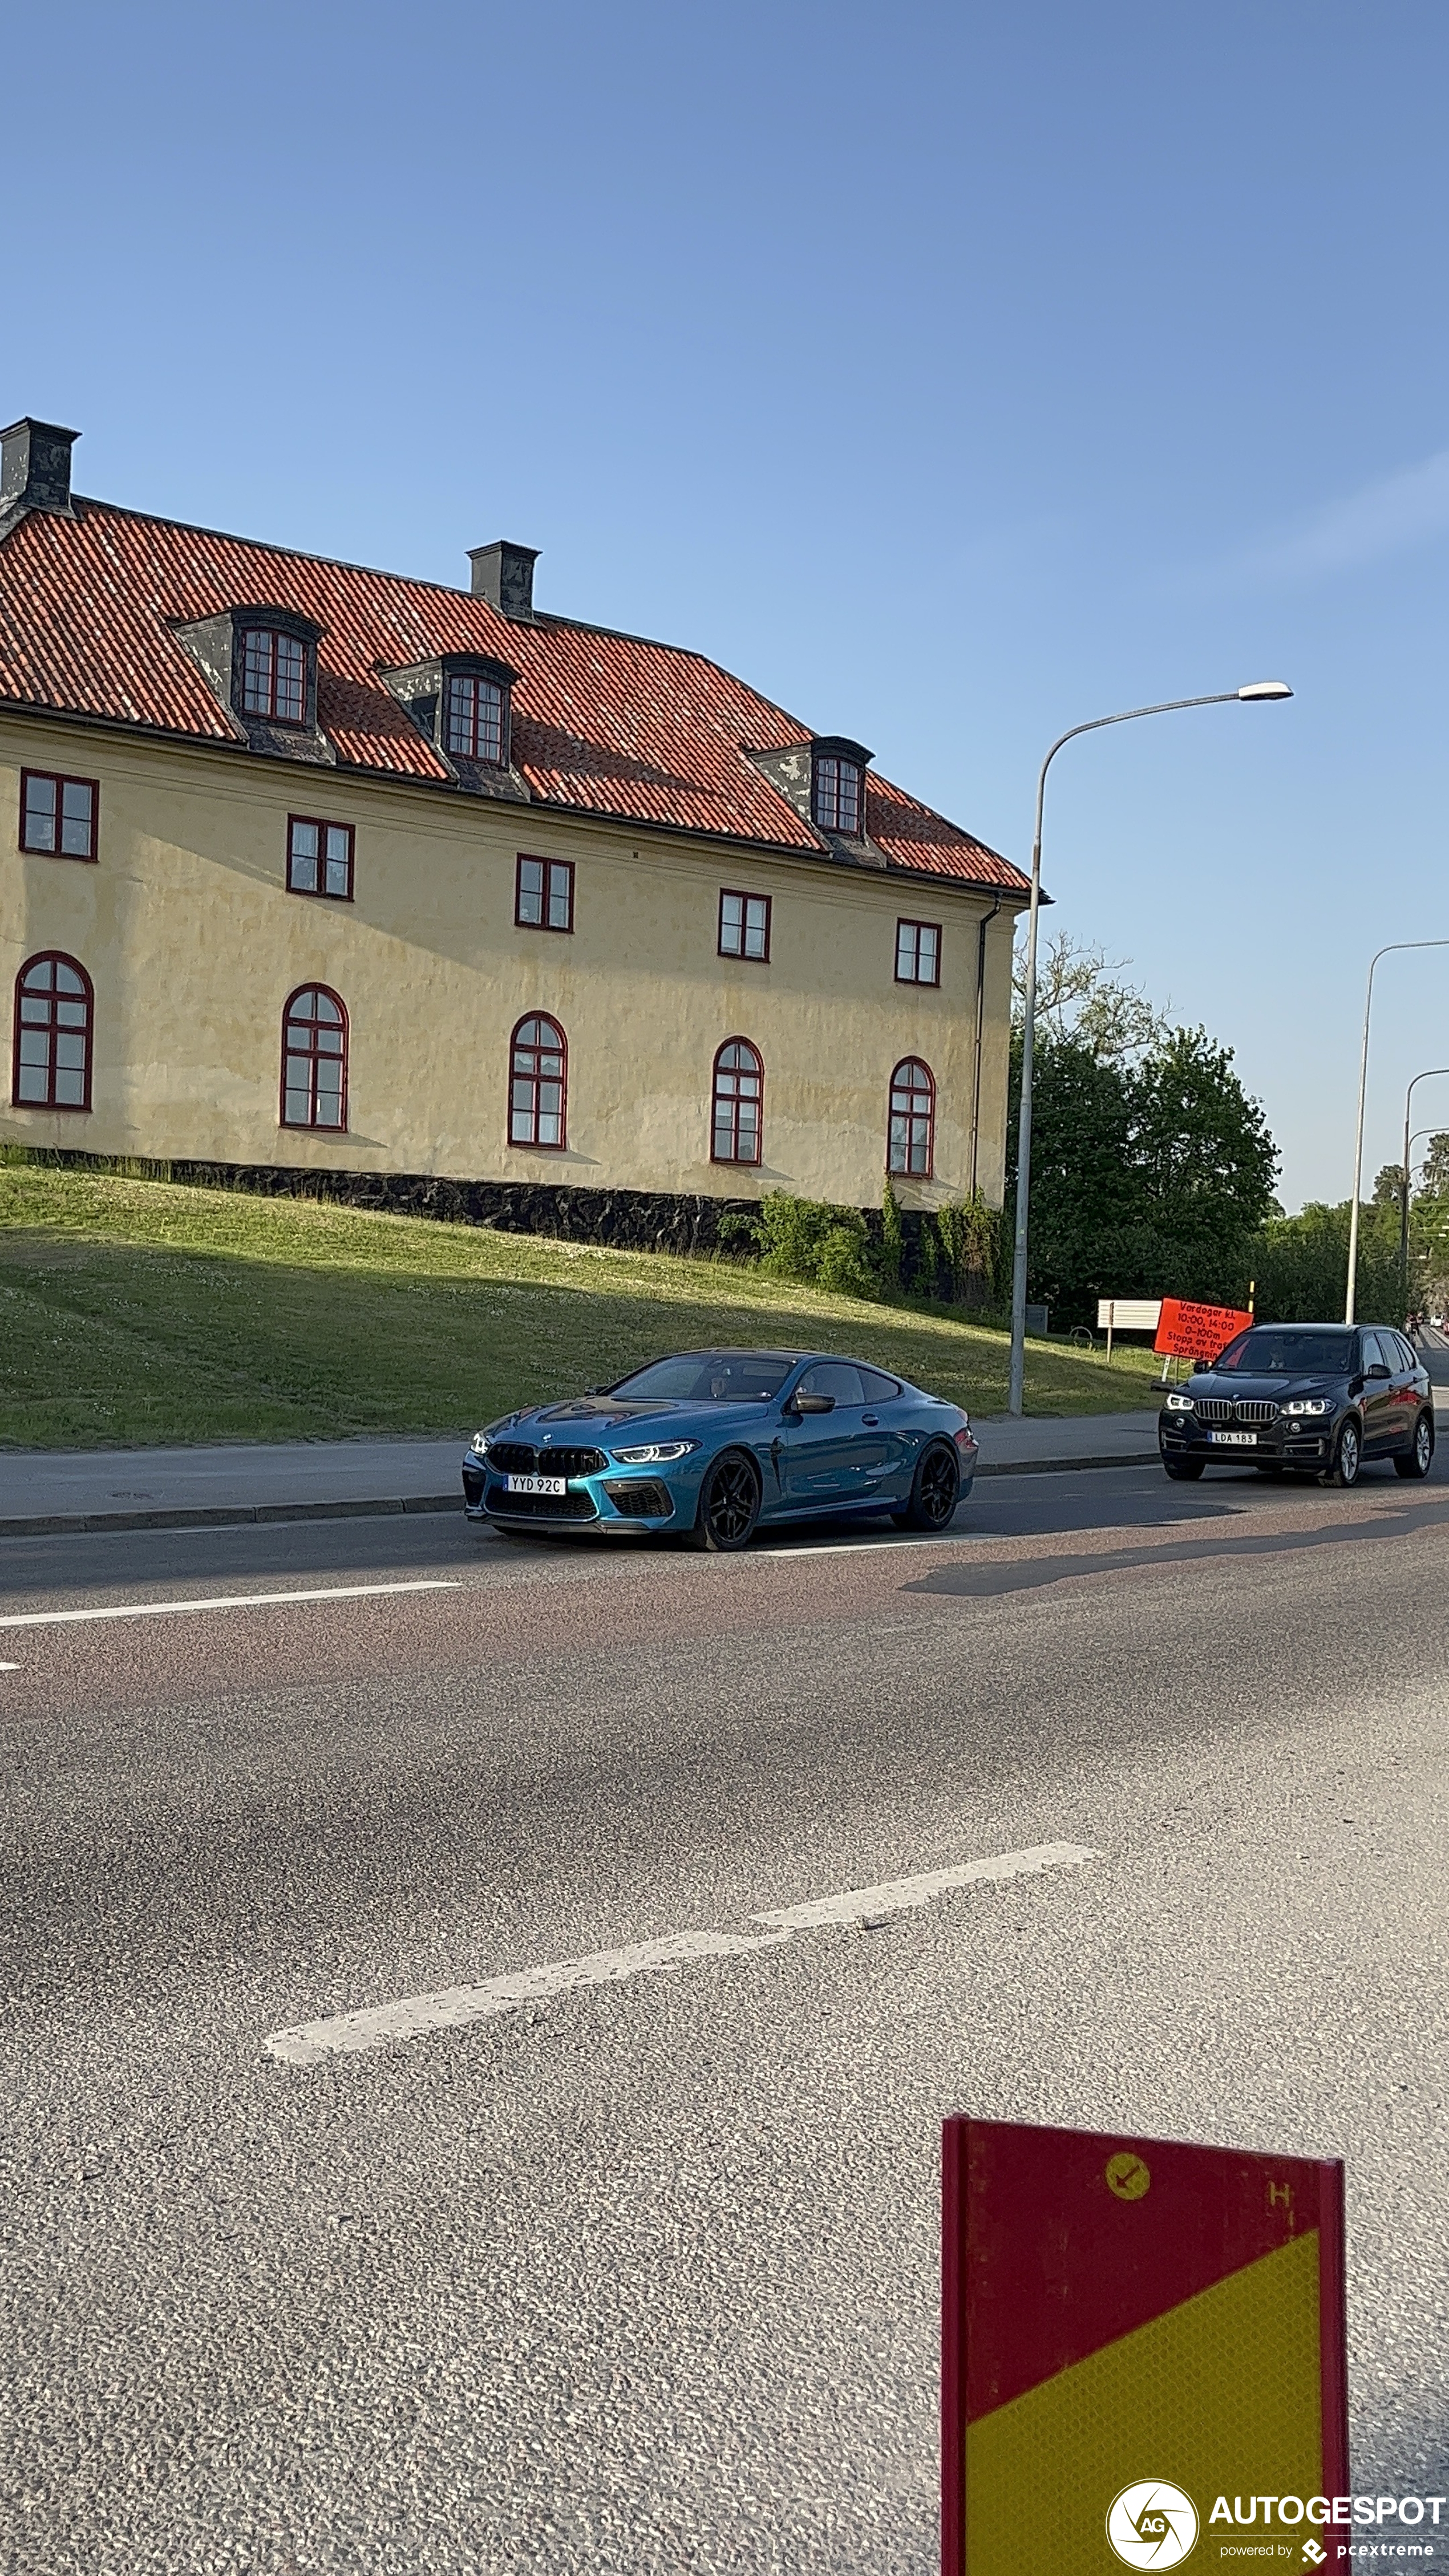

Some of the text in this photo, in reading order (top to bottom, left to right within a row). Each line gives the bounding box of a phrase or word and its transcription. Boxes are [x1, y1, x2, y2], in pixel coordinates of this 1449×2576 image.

[1180, 1302, 1222, 1317] Vardagar
[1209, 1318, 1234, 1331] 14:00
[1167, 1331, 1192, 1345] Stopp
[1215, 1433, 1253, 1443] LDA 183
[512, 1477, 561, 1493] YYD 92C
